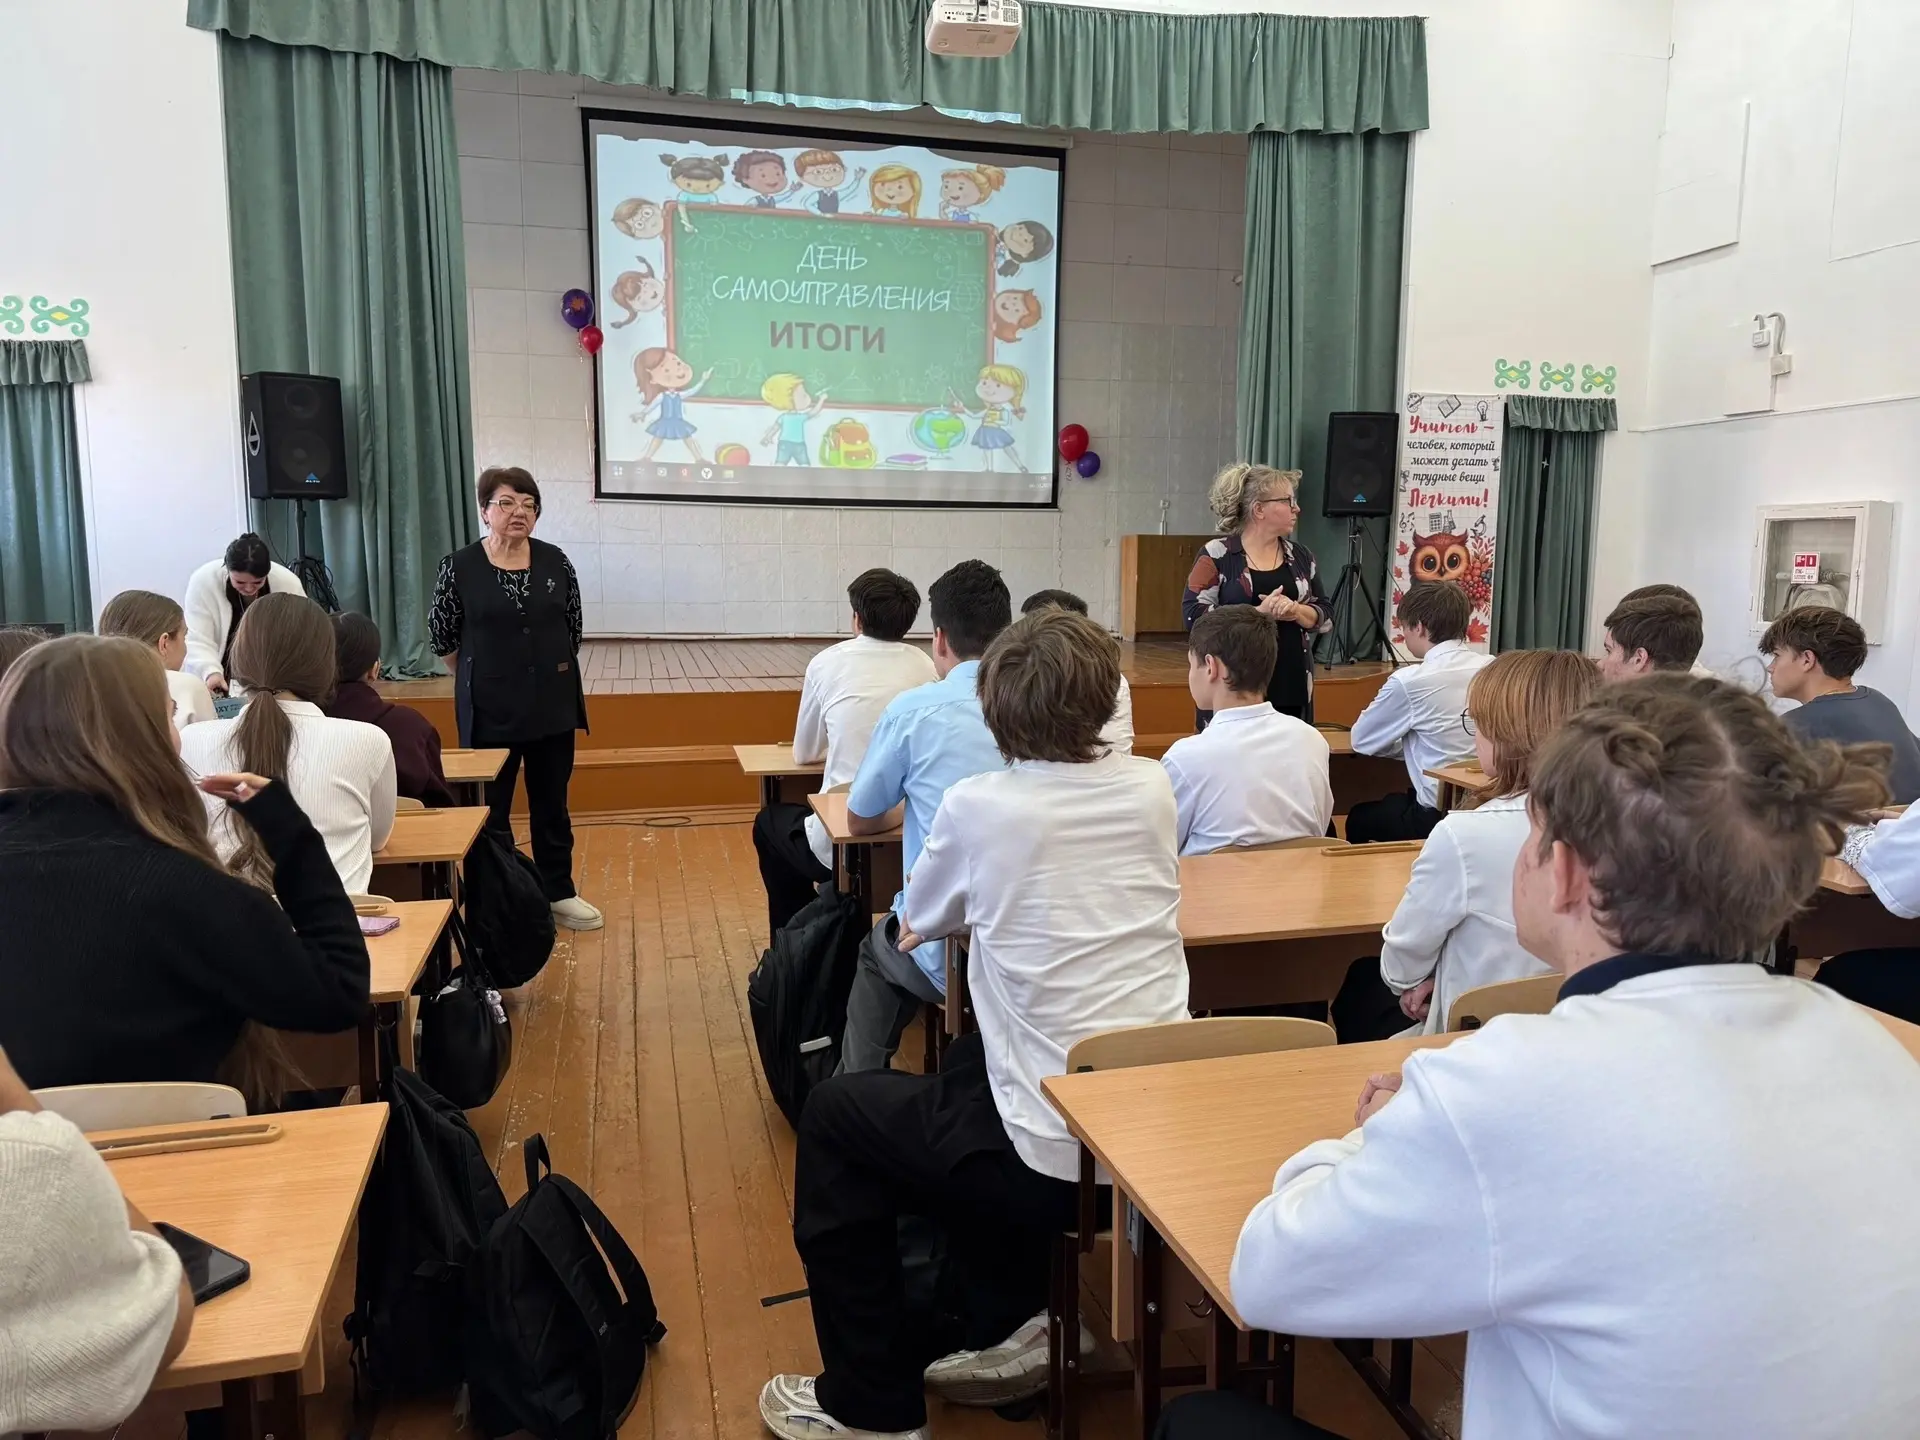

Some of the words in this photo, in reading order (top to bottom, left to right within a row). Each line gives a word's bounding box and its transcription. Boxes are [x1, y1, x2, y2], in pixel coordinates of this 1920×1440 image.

[796, 243, 868, 274] ДЕНЬ
[712, 275, 951, 312] САМОУПРАВЛЕНИЯ
[769, 320, 885, 354] ИТОГИ
[1409, 415, 1478, 433] Учитель
[1407, 439, 1447, 451] человек,
[1449, 440, 1495, 455] который
[1410, 457, 1449, 466] может
[1451, 457, 1488, 470] делать
[1412, 472, 1457, 486] трудные
[1459, 471, 1485, 484] вещи
[1408, 487, 1489, 508] Лёгкими!
